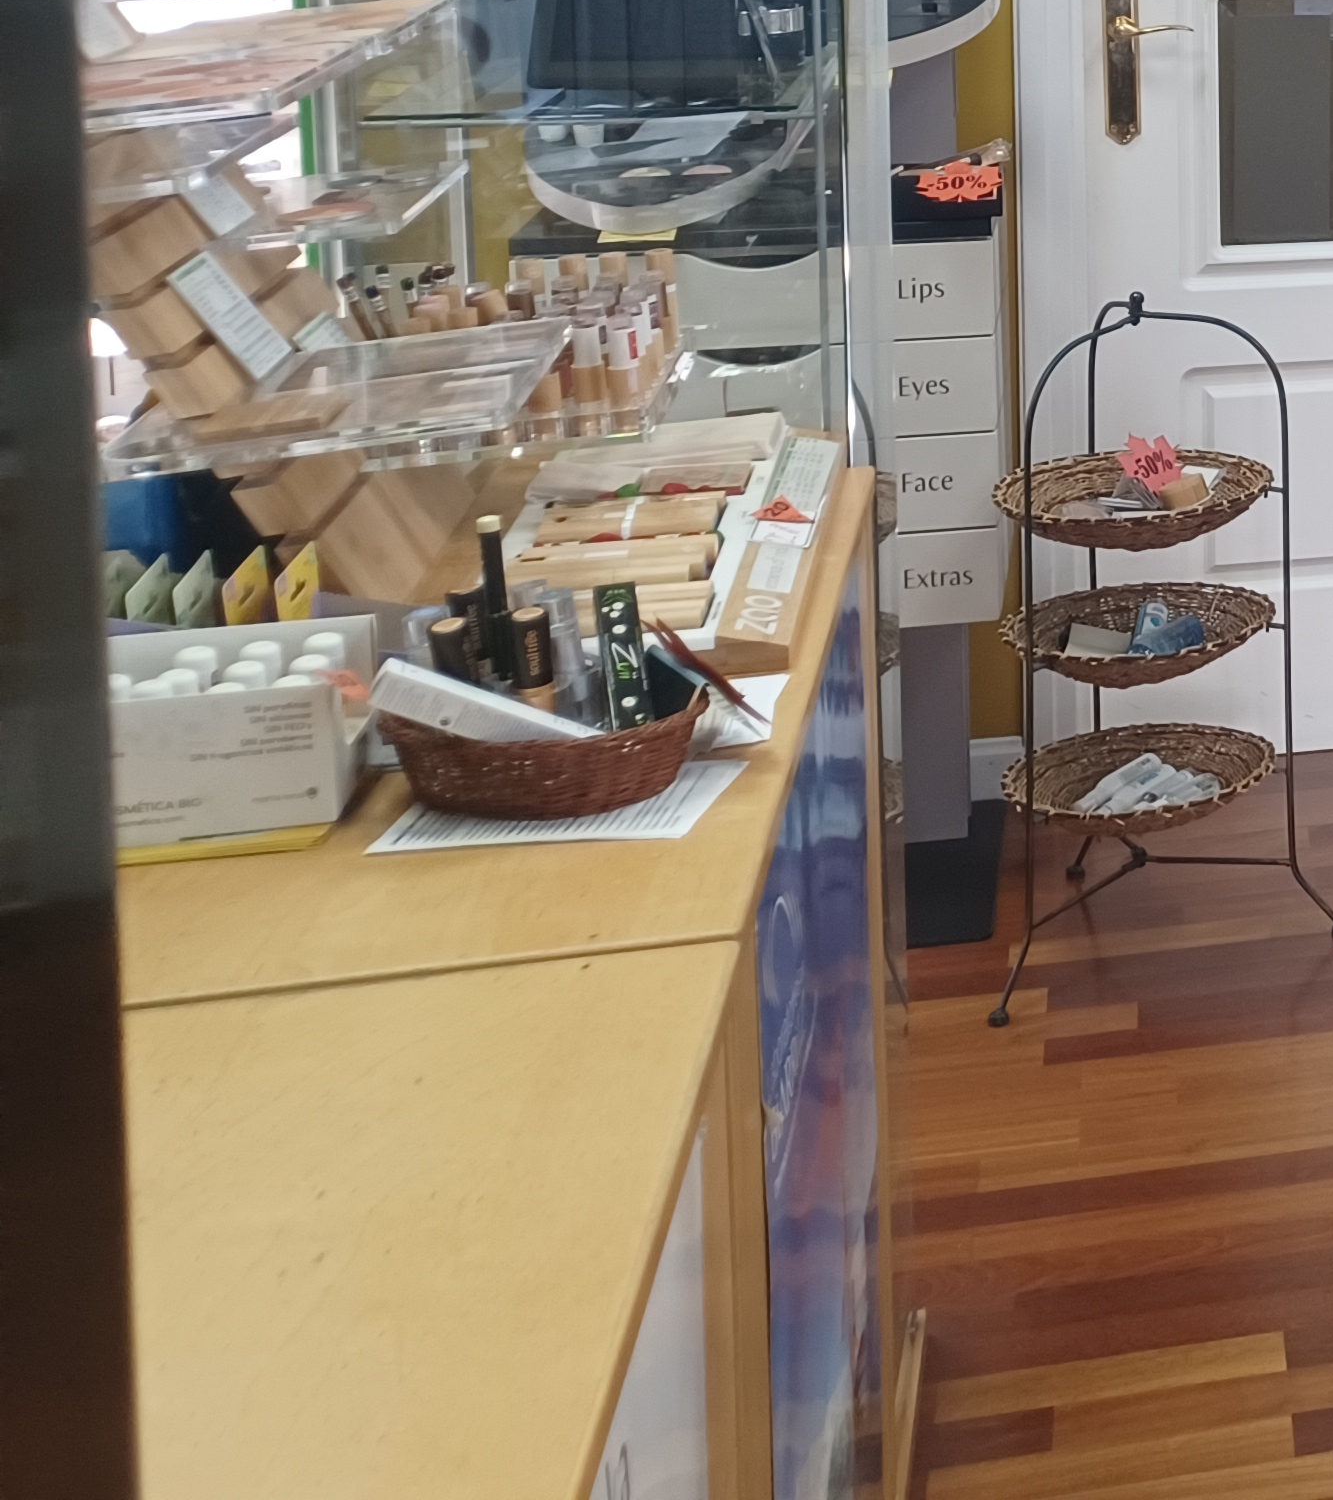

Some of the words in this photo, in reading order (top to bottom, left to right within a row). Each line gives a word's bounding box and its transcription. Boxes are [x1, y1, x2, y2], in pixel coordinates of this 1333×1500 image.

[927, 174, 987, 190] -50%
[898, 278, 945, 304] Lips
[898, 376, 950, 403] Eyes
[901, 472, 954, 493] Face
[903, 568, 974, 591] Extras
